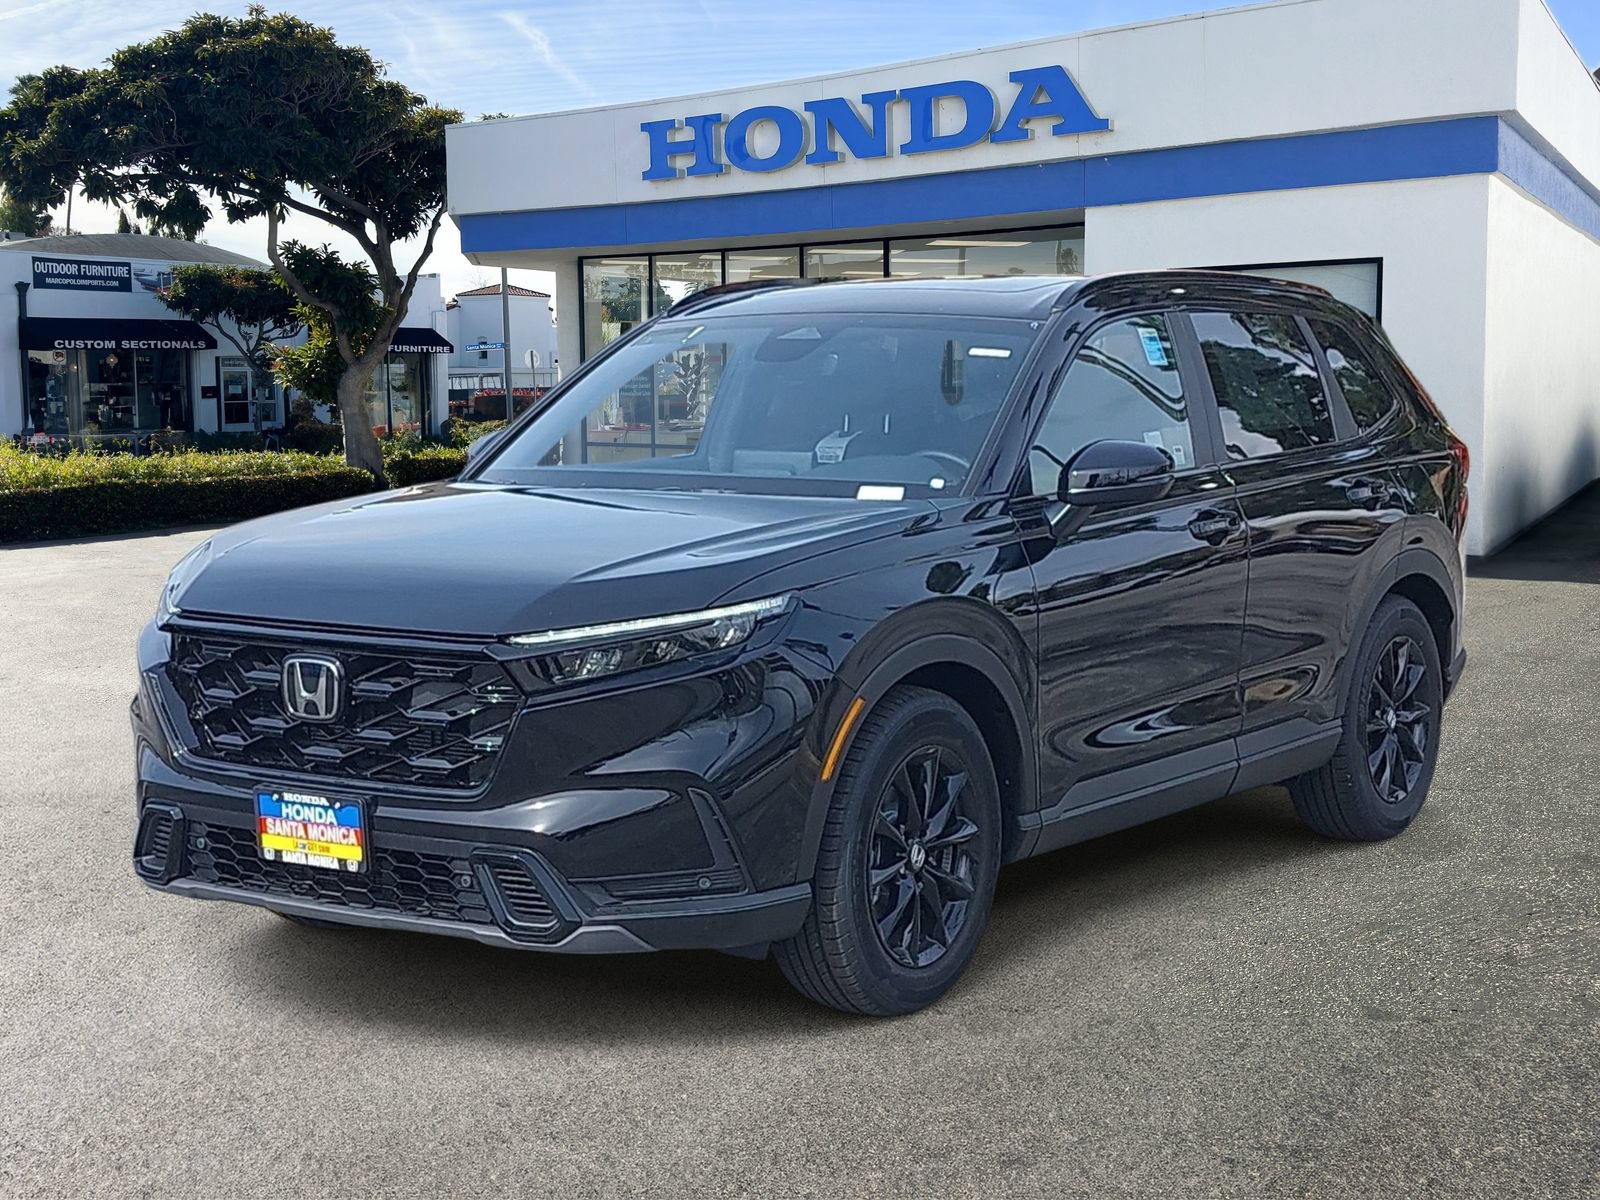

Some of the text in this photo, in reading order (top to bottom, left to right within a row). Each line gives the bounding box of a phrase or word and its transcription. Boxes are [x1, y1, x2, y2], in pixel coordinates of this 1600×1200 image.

[640, 64, 1111, 181] HONDA
[34, 261, 130, 278] OUTDOOR FURNITURE
[45, 277, 119, 287] MARCOPOLOIMPORTS.COM
[54, 339, 206, 349] CUSTOM SECTIONALS
[389, 344, 450, 353] FURNITURE
[283, 791, 330, 806] HONDA
[281, 803, 338, 825] HONDA
[266, 817, 358, 845] SANTA MONICA
[282, 849, 340, 870] SANTA MONICA
